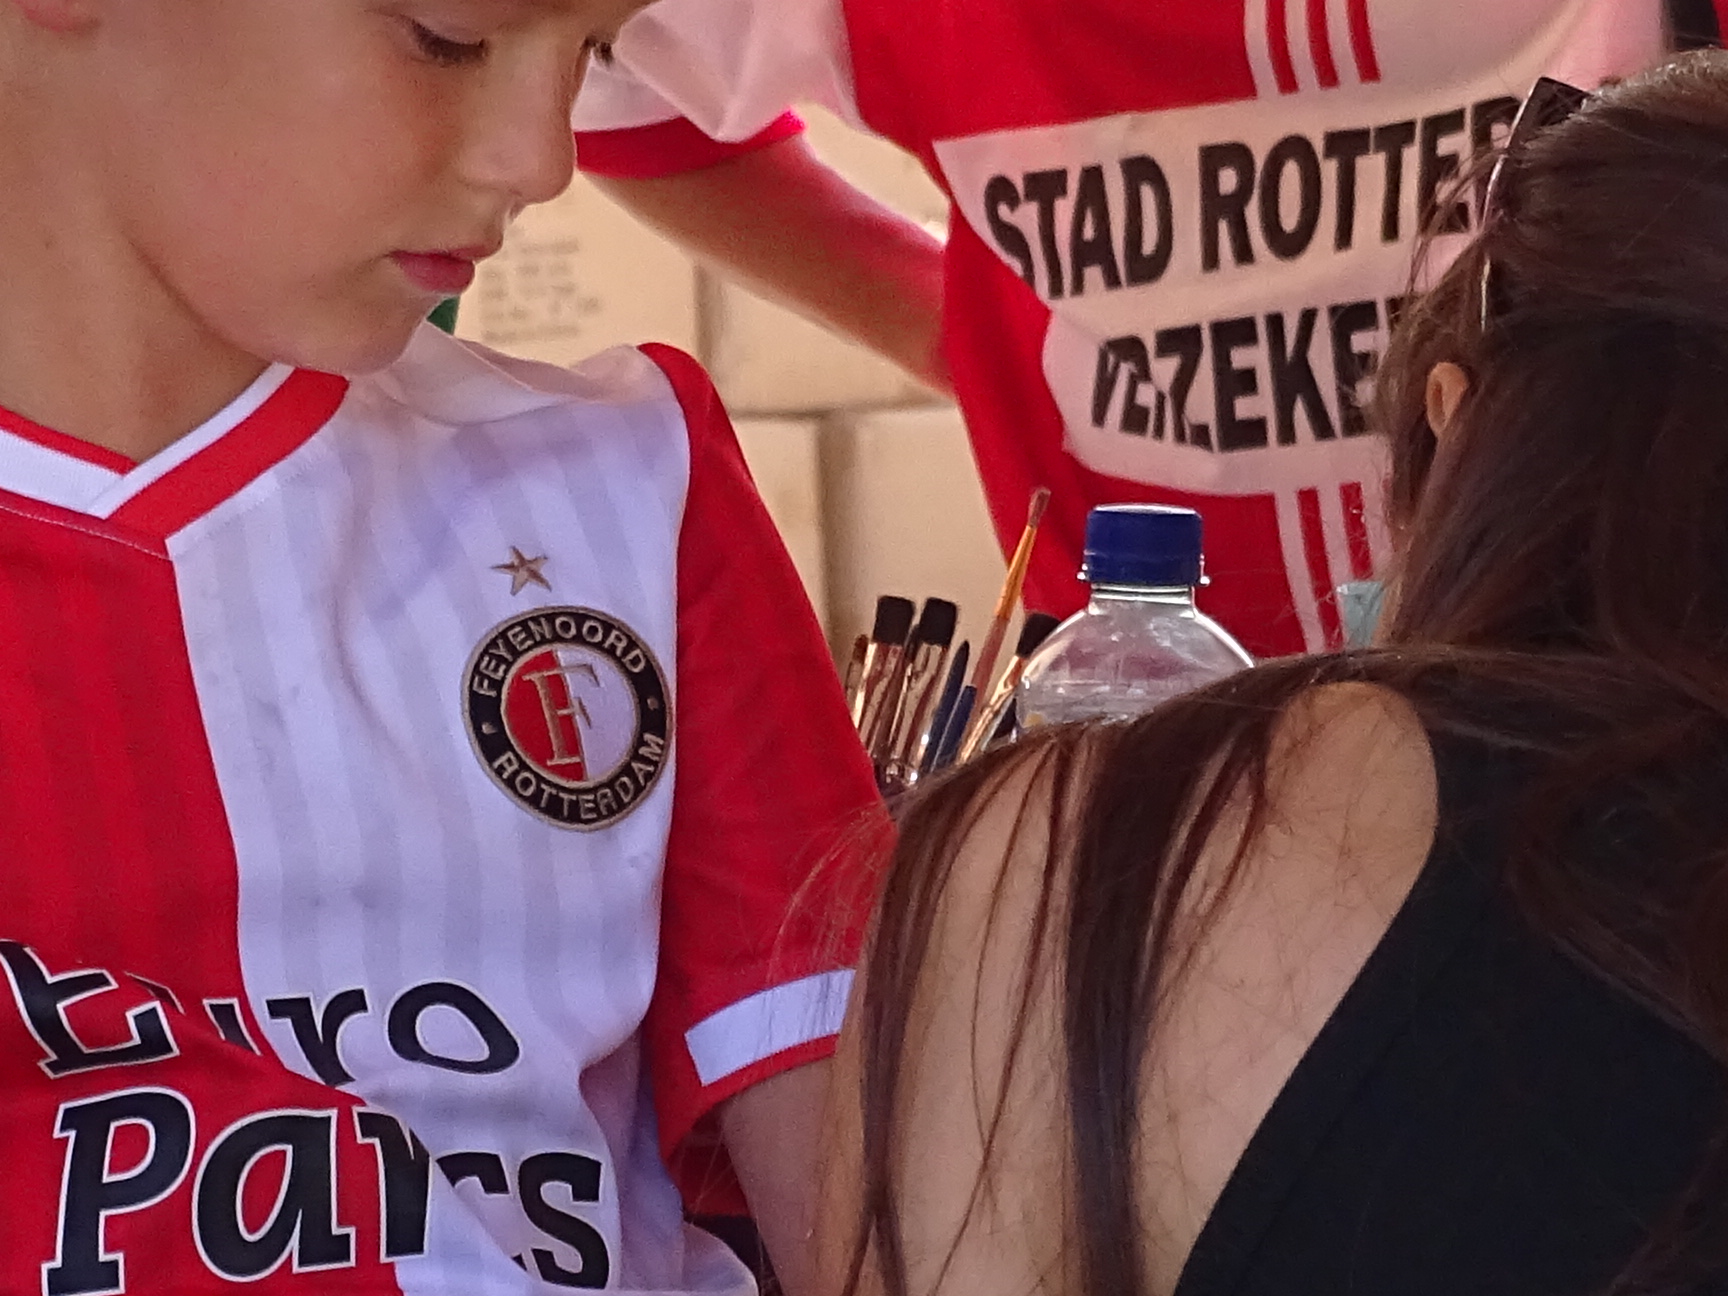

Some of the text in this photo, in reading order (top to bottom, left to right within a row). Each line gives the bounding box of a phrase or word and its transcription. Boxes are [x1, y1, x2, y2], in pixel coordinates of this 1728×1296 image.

[983, 153, 1174, 301] STAD
[473, 616, 647, 697] FEYENOORD
[522, 663, 602, 766] F
[492, 732, 665, 820] ROTTERDAM
